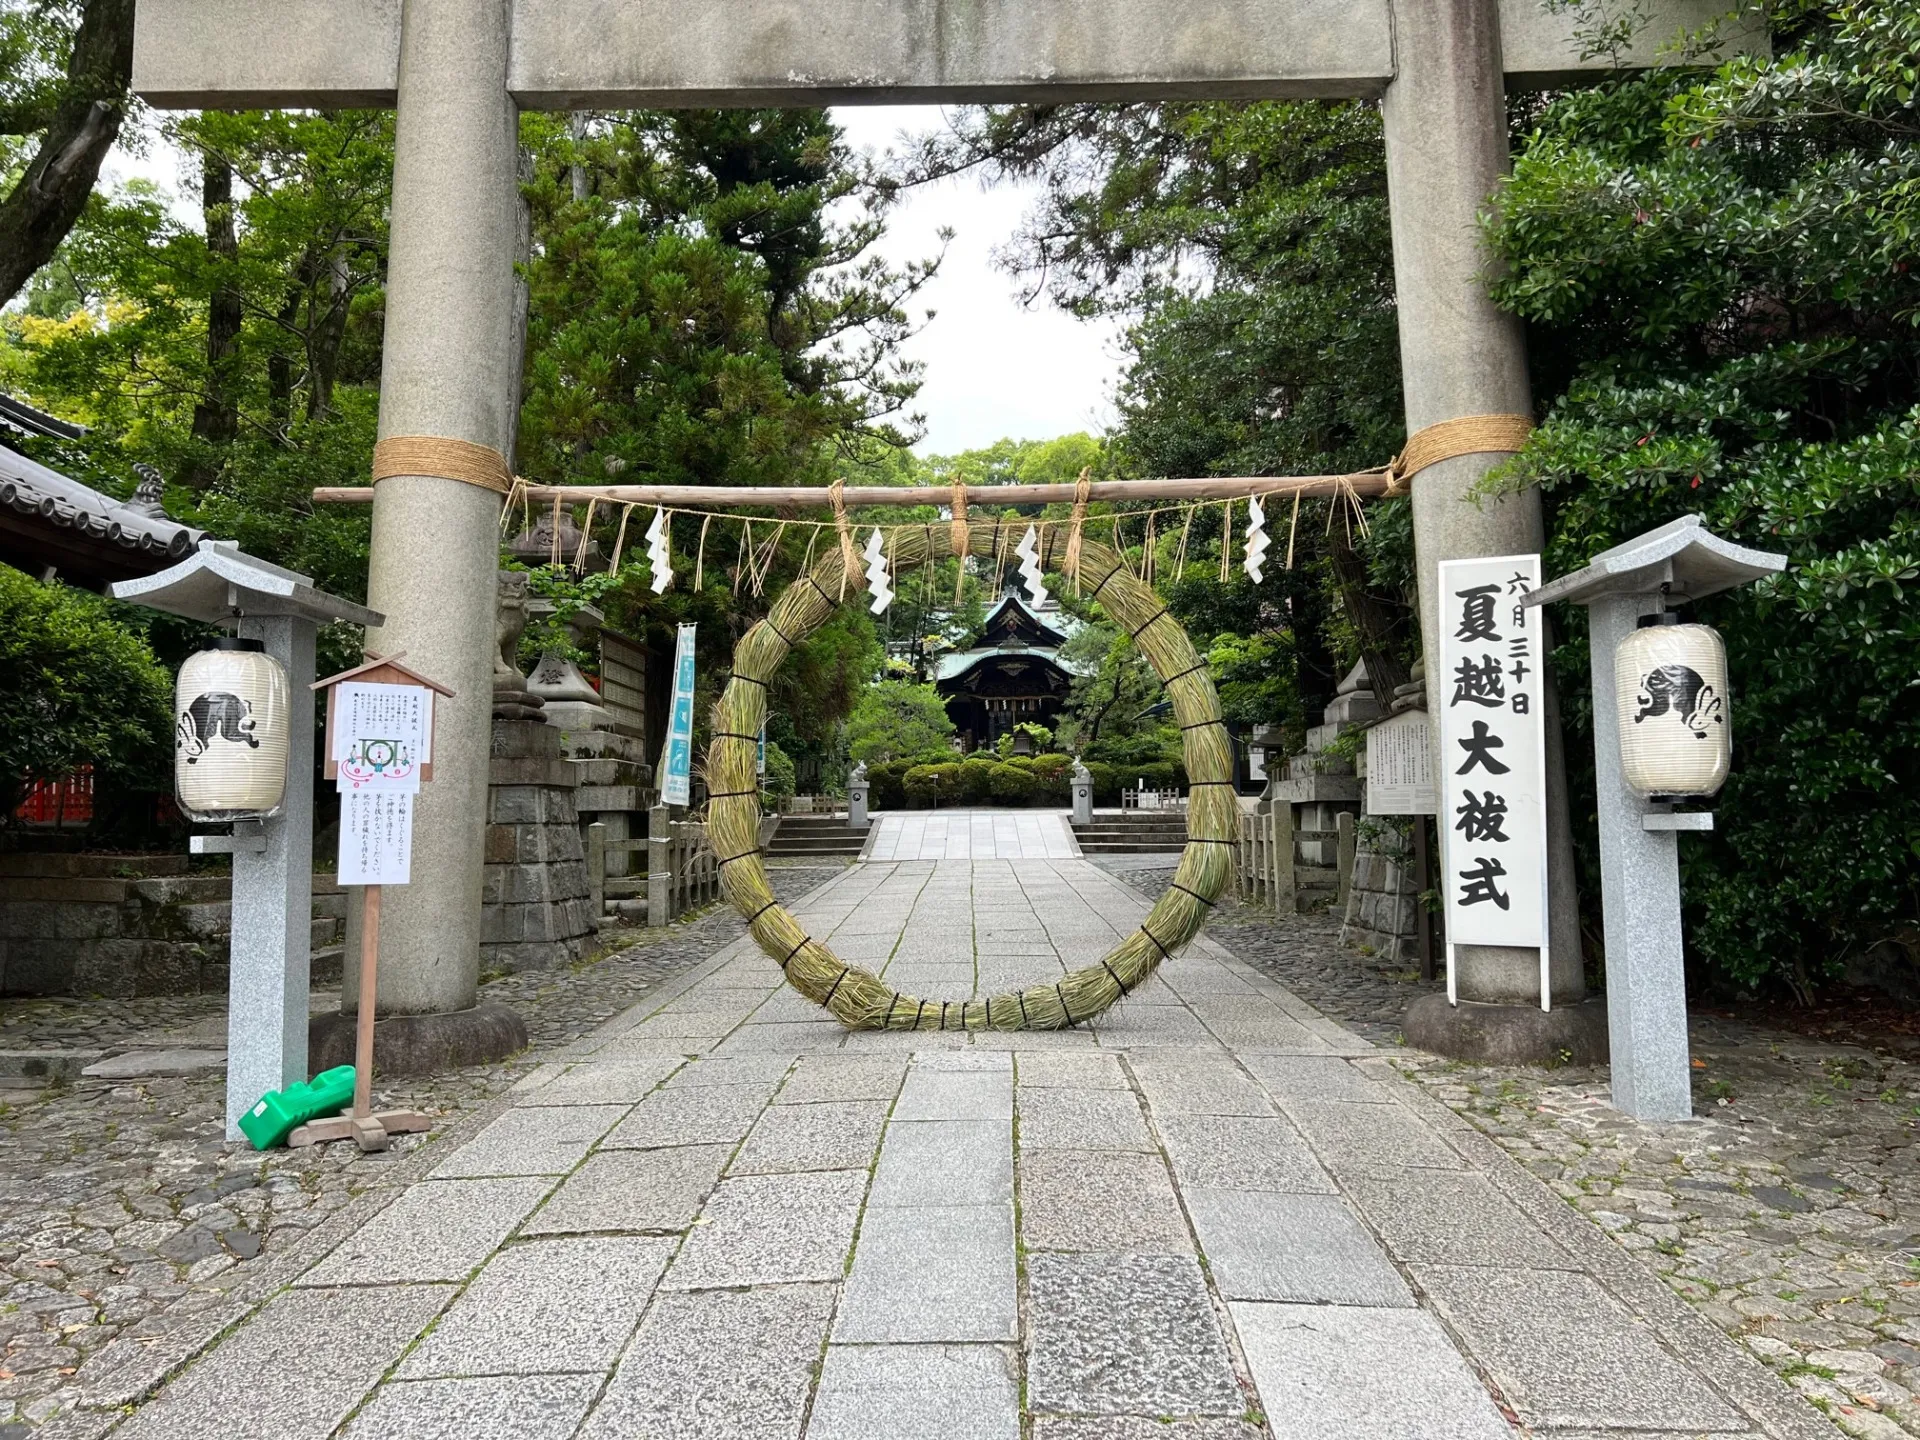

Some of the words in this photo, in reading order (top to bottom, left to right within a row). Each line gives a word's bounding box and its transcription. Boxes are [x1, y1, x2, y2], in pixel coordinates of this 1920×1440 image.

[1449, 583, 1512, 911] 夏越大祓式
[1506, 571, 1532, 715] 六月三十日
